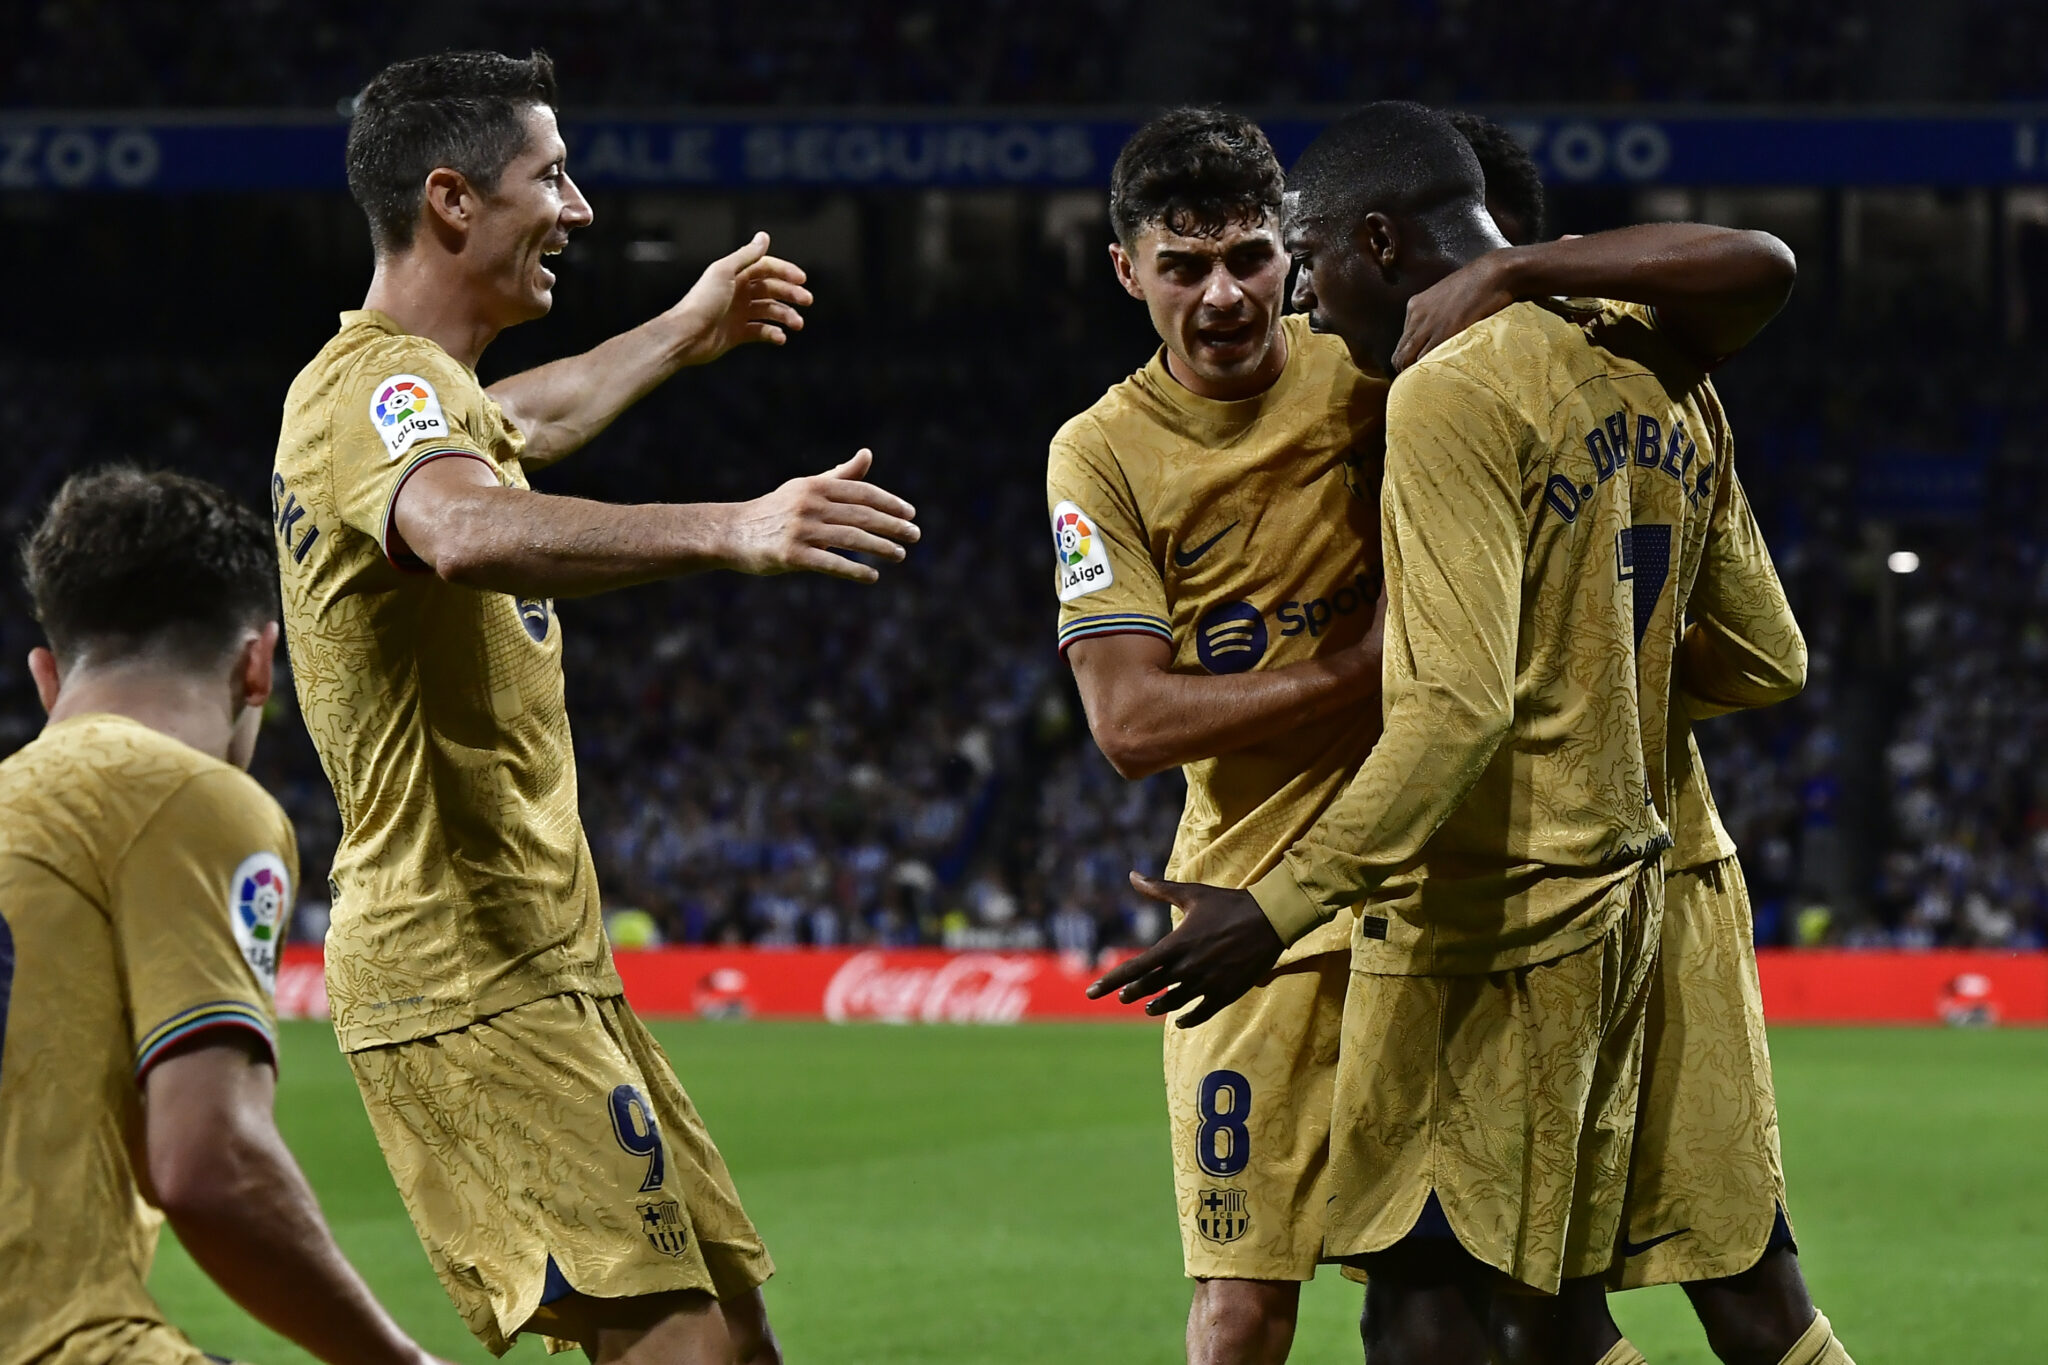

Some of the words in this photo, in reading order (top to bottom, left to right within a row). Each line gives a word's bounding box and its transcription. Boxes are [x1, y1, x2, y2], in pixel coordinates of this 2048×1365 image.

[570, 129, 714, 180] ALE
[744, 127, 1095, 182] SEGUROS
[391, 418, 440, 450] LaLiga
[1064, 563, 1105, 589] LaLiga
[1276, 572, 1380, 638] Spot
[608, 1084, 665, 1192] 9
[1196, 1069, 1251, 1178] 8
